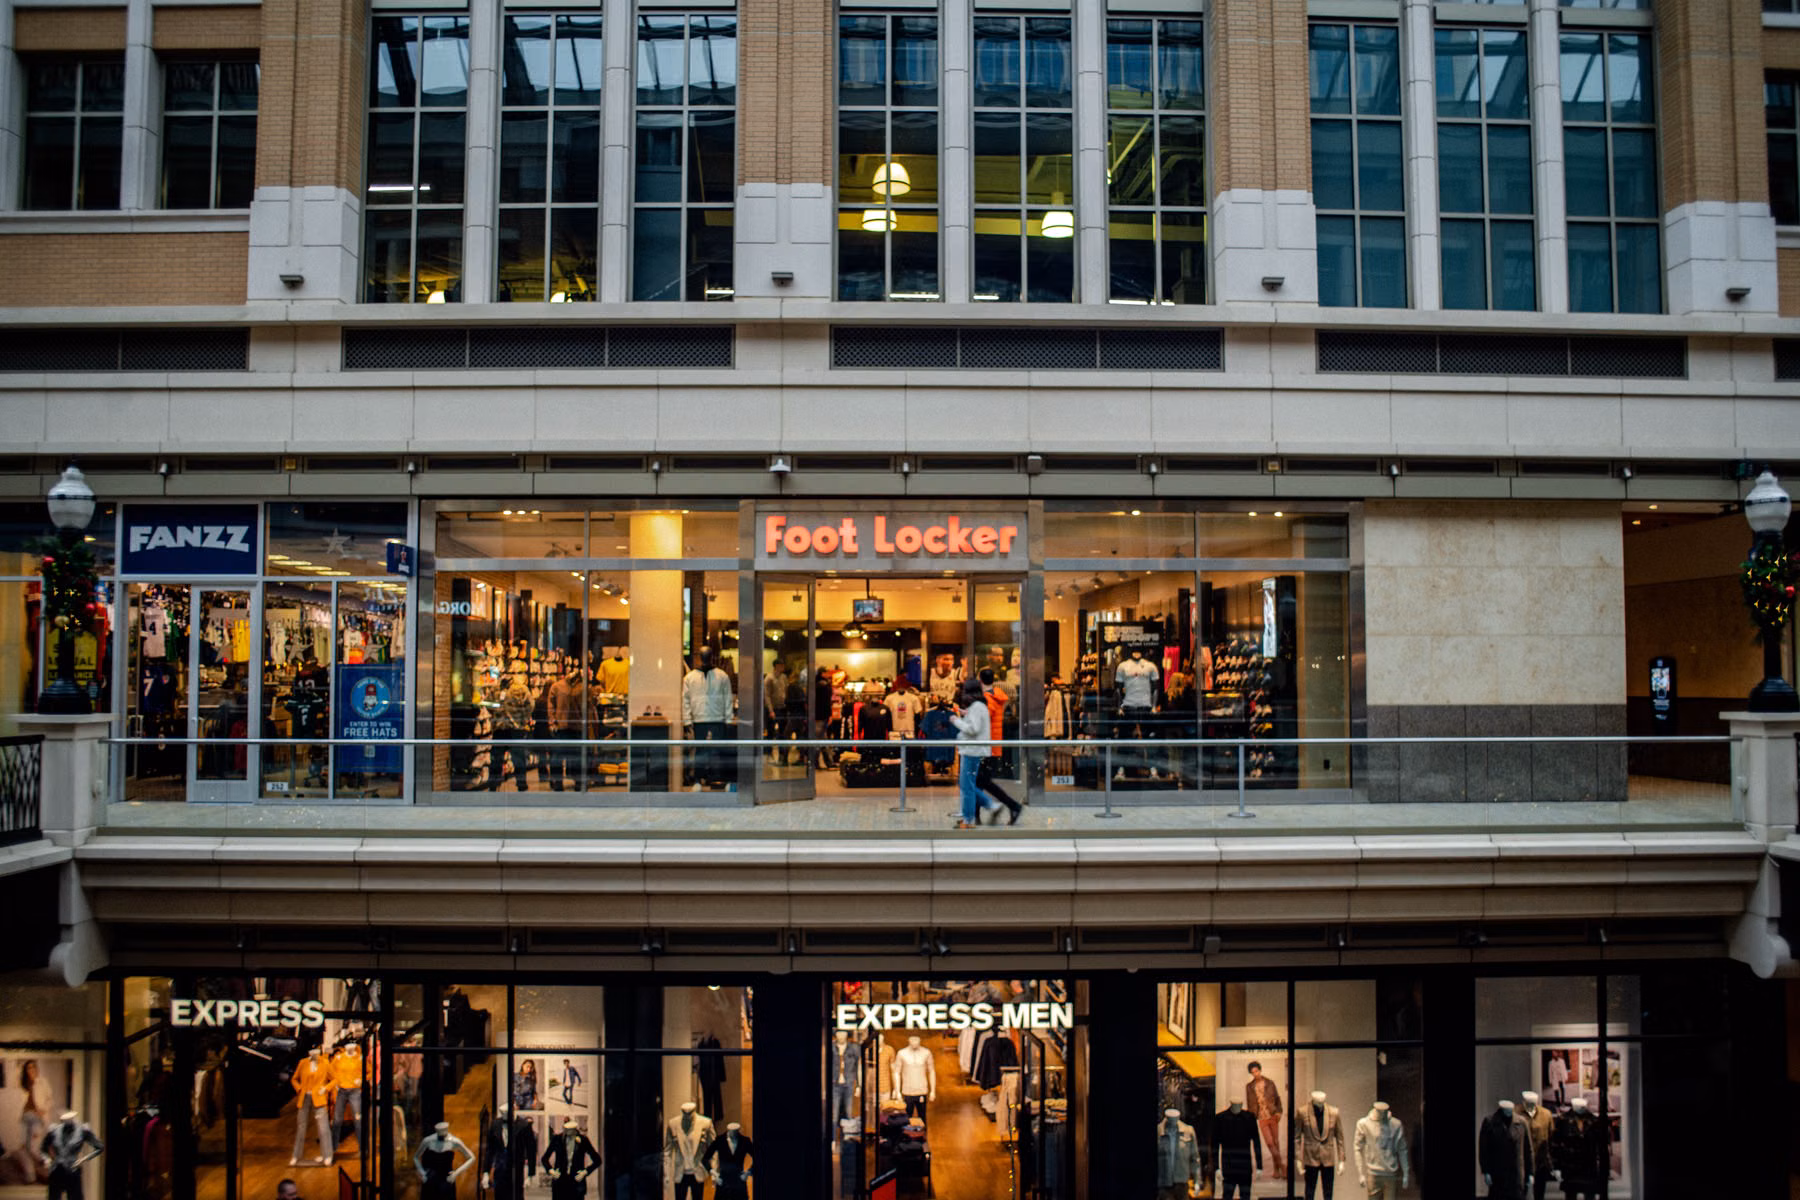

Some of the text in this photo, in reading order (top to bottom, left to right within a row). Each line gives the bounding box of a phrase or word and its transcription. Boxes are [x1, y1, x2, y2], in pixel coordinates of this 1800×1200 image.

[129, 525, 250, 553] FANZZ
[765, 515, 1018, 554] Foot Locker
[343, 727, 398, 737] FREE HATS
[170, 999, 325, 1028] EXPRESS
[836, 1002, 1074, 1030] EXPRESS MEN
